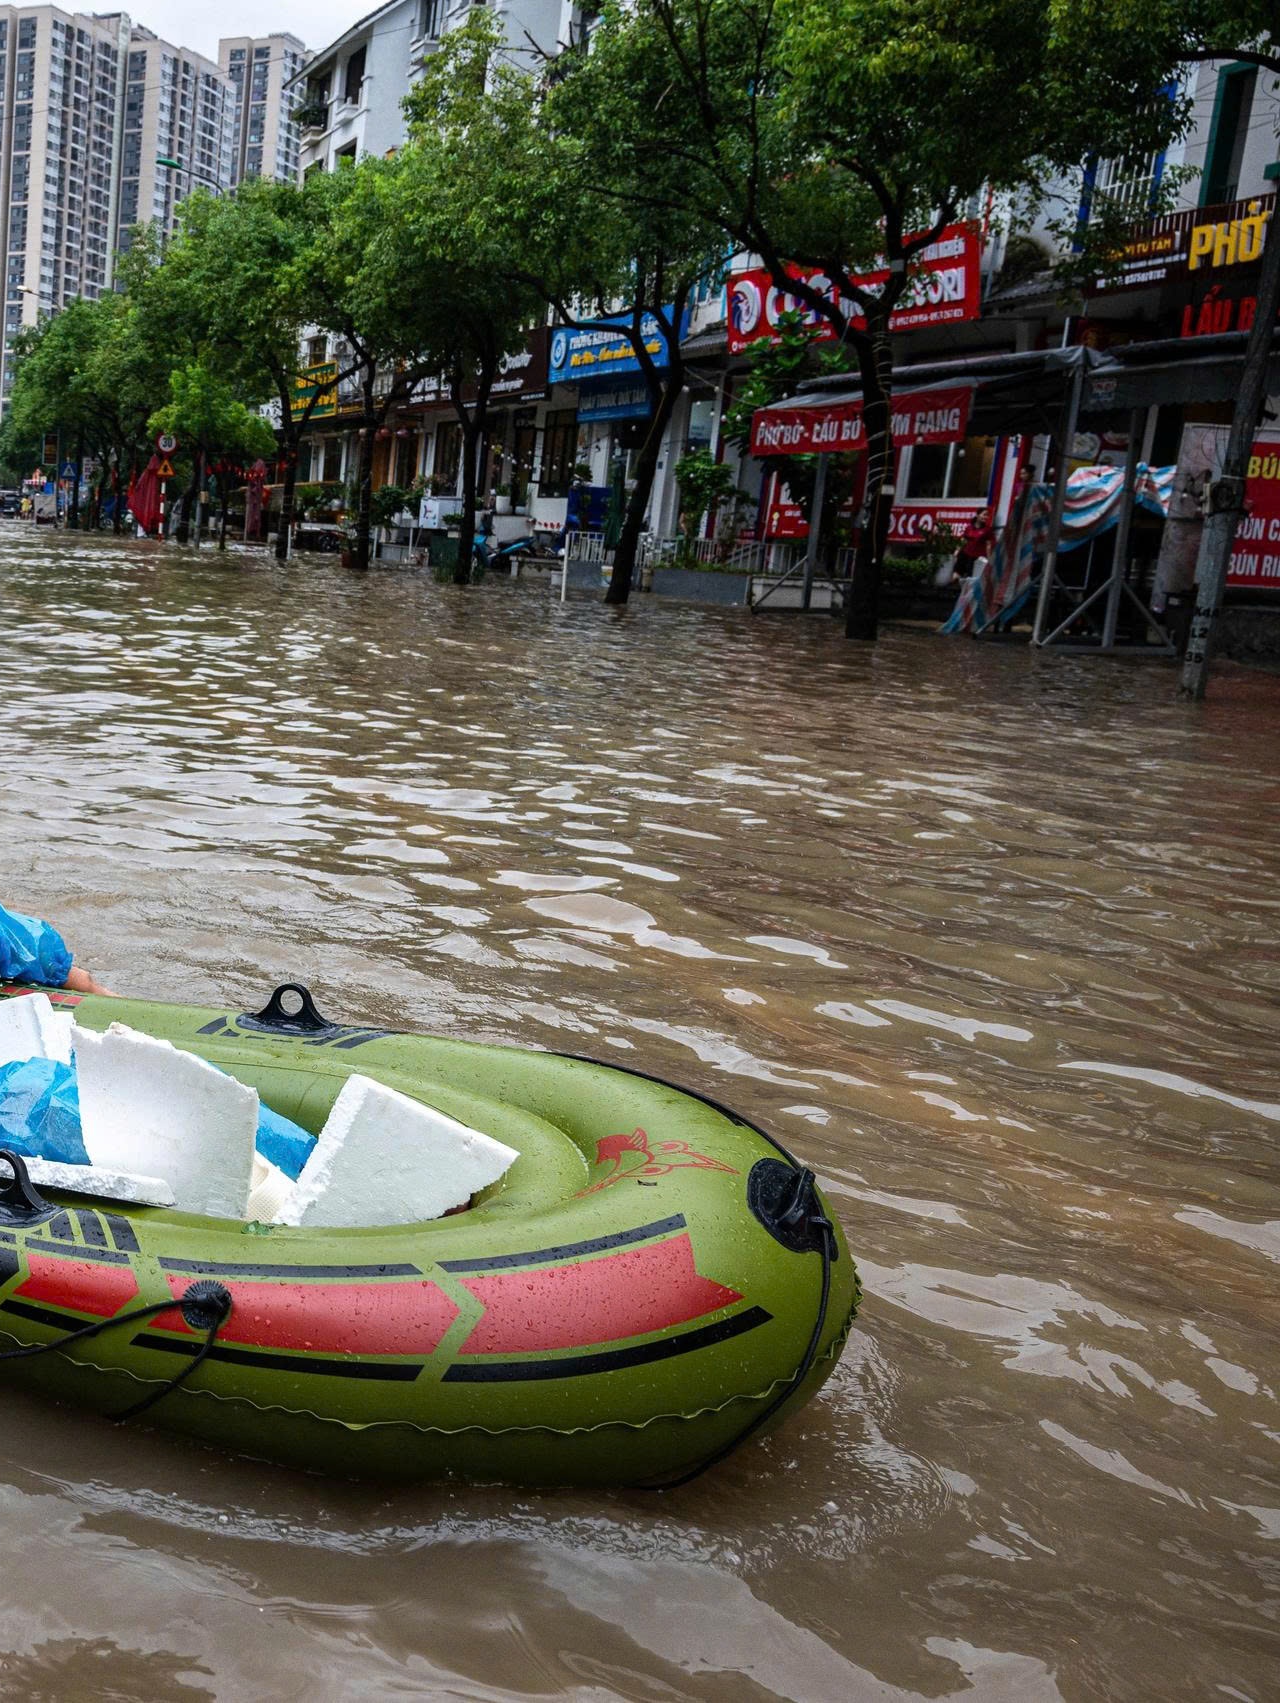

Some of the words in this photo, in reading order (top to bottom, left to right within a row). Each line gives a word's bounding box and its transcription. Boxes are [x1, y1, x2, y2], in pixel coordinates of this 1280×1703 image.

[1188, 200, 1272, 271] PHỞ
[162, 438, 173, 448] 30
[1268, 518, 1280, 542] C
